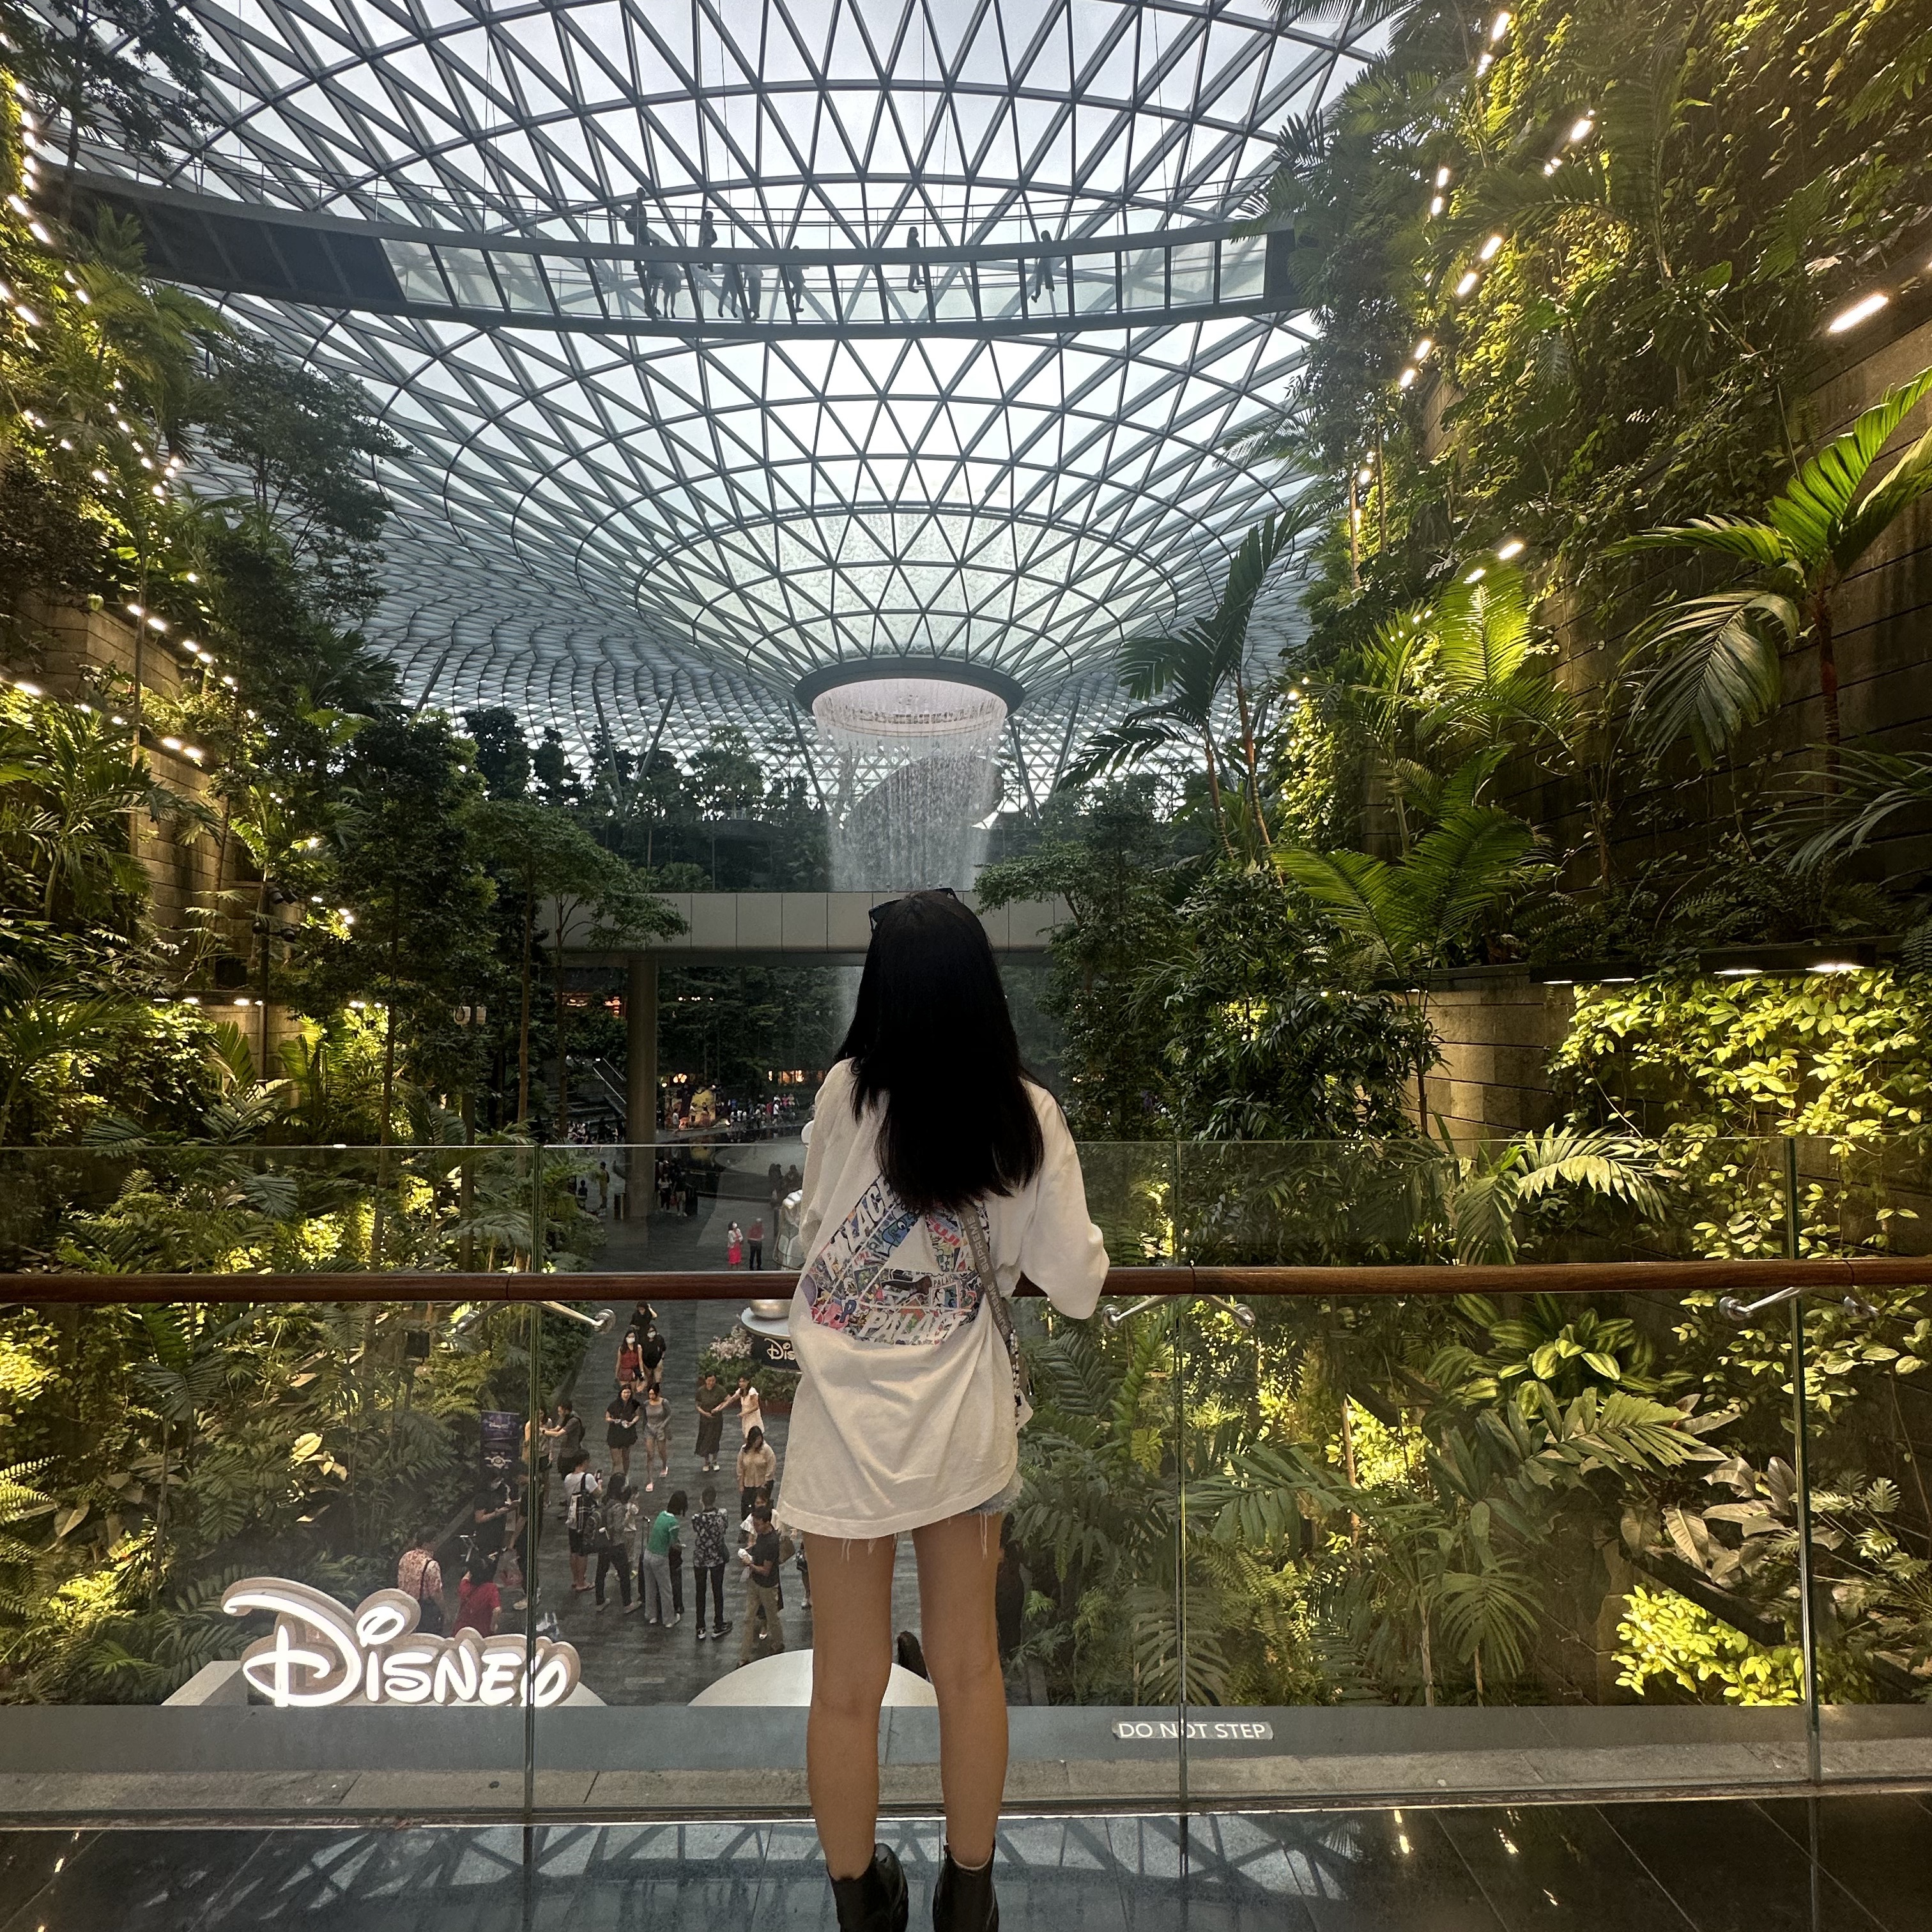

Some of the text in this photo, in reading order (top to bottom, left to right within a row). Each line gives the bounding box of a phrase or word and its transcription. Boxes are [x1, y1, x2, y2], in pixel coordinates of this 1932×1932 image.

[967, 1216, 989, 1273] SUPREME
[764, 1338, 796, 1360] Dis
[1118, 1723, 1266, 1738] DO NOT STEP
